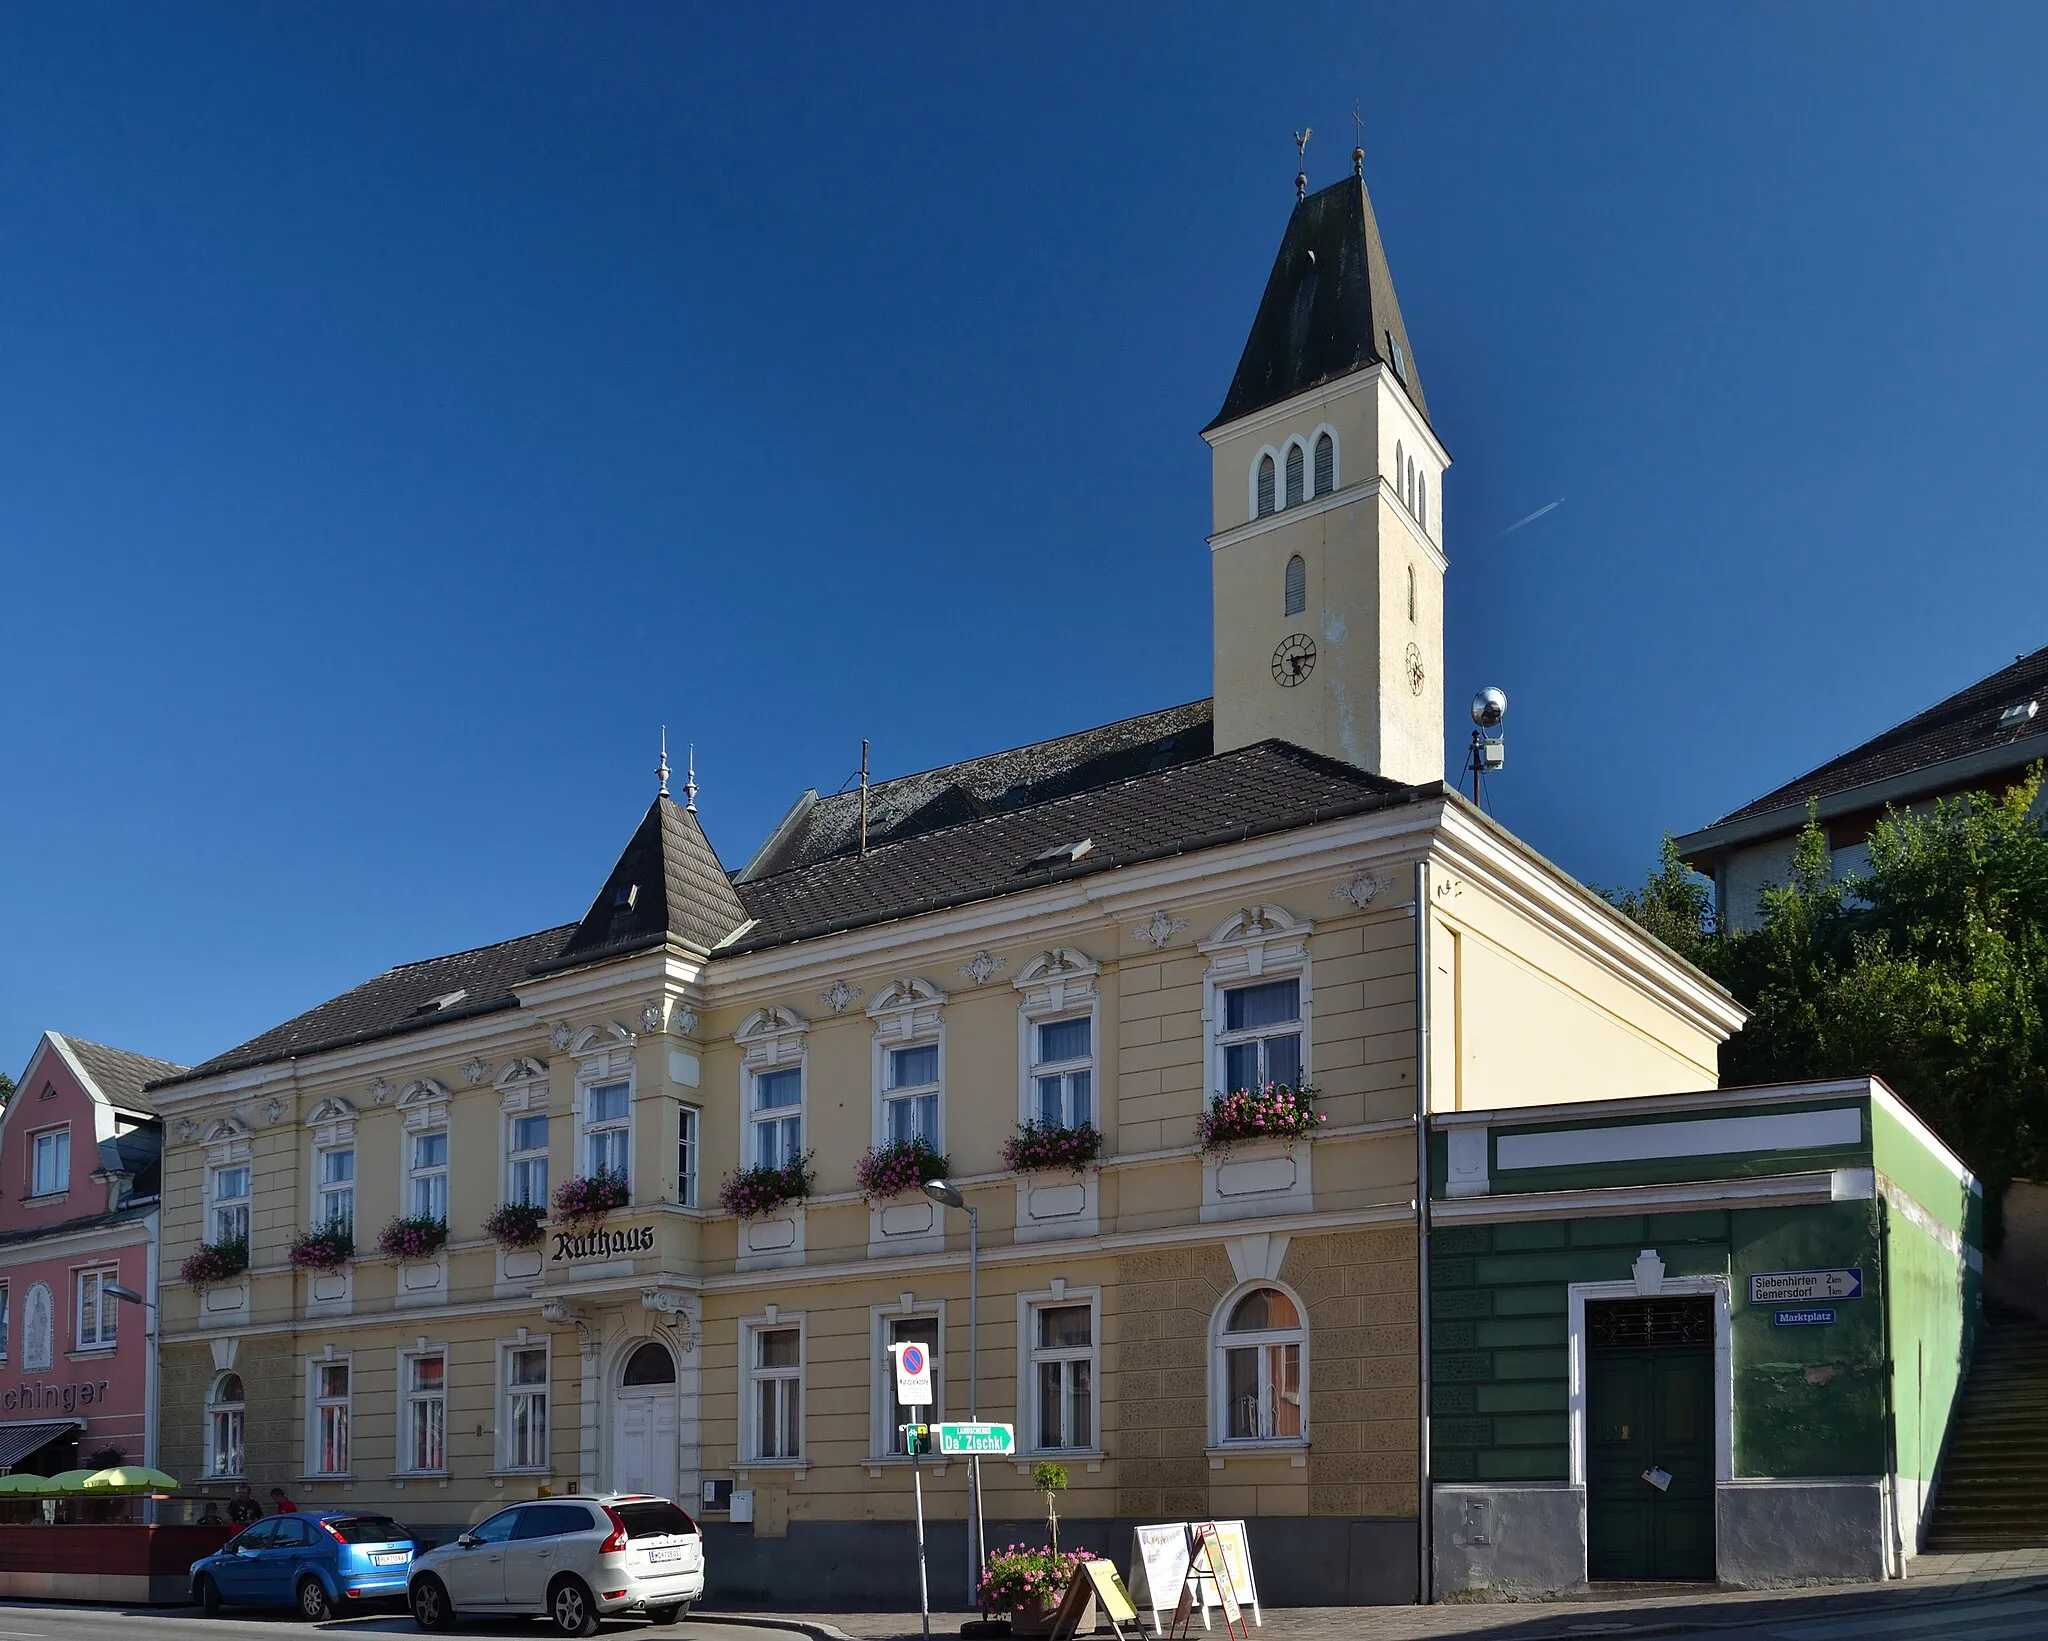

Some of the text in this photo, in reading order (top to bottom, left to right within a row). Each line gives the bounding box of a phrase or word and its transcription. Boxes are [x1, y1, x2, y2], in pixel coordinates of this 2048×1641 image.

[552, 1226, 655, 1261] Rathaus
[1755, 1276, 1817, 1288] Siebenhirten
[1756, 1287, 1812, 1299] Gemersdorf
[1780, 1313, 1831, 1322] Marktplatz
[0, 1380, 109, 1413] chinger
